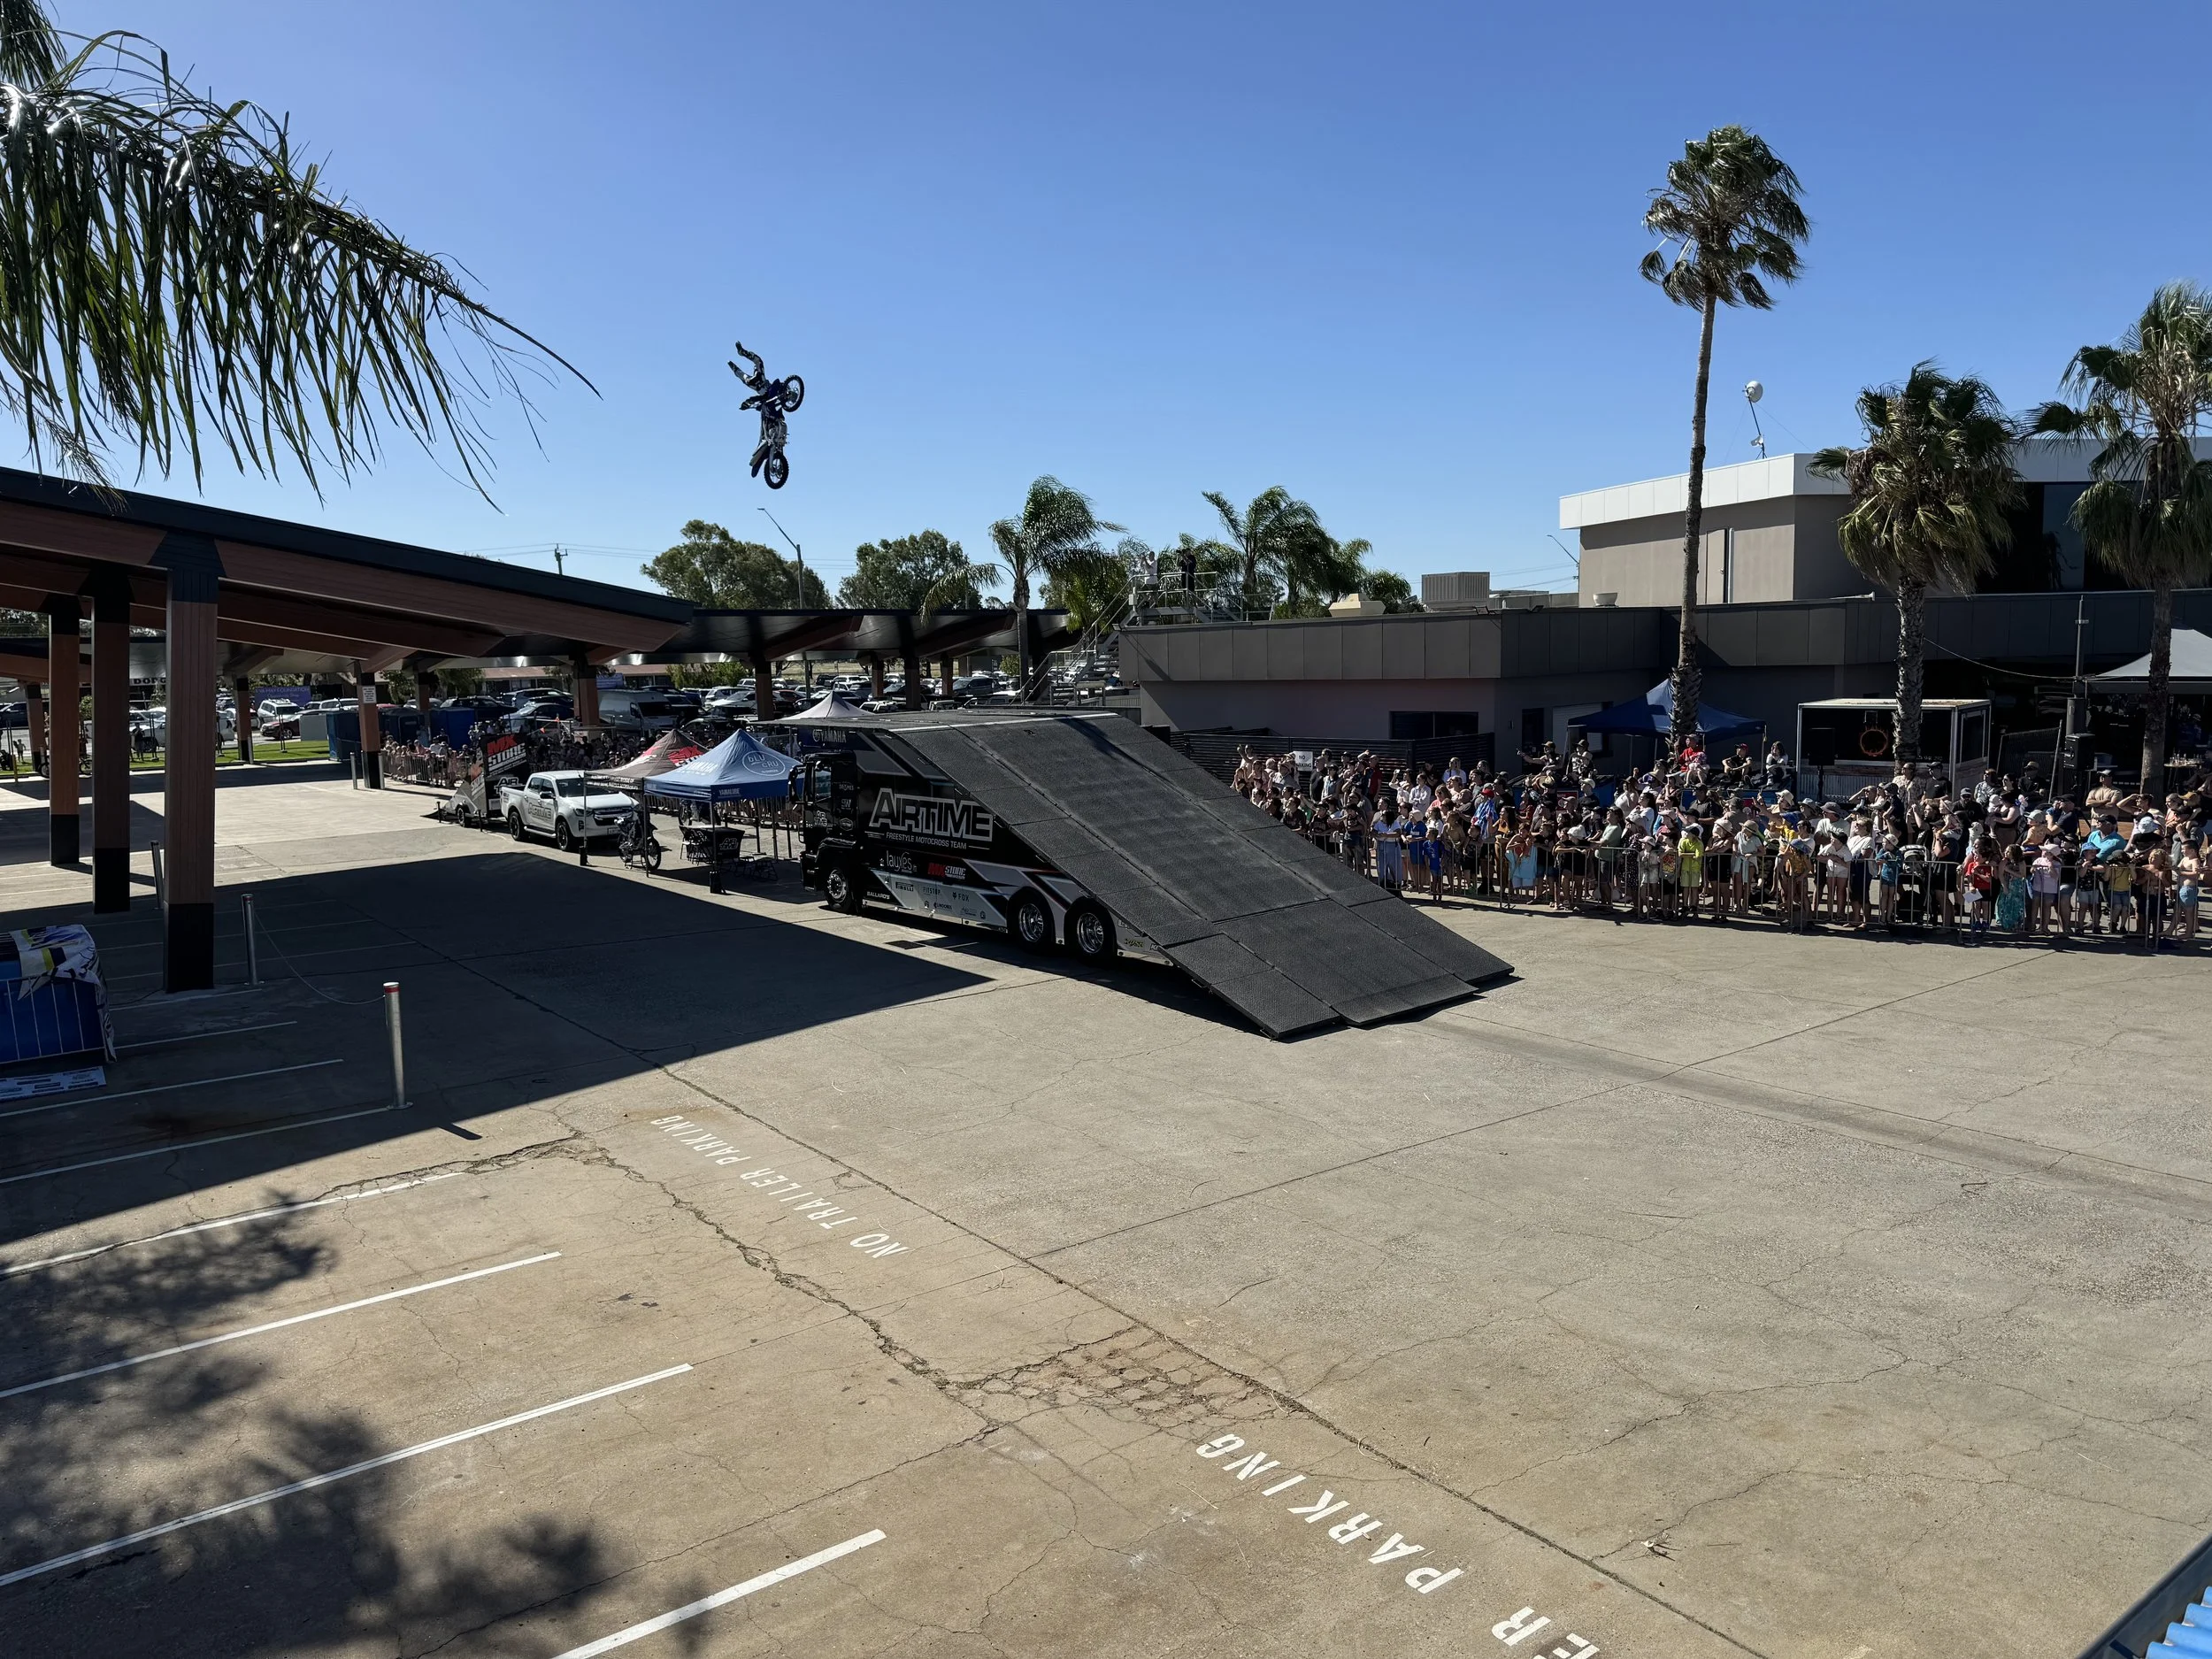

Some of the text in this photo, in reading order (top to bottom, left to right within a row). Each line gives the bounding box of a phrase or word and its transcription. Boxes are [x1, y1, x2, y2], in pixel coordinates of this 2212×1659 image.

[488, 734, 518, 756] MX
[821, 729, 847, 743] YAMAHA
[488, 743, 526, 766] STORE
[886, 832, 967, 849] FREESTYLE MOTOCROSS TEAM
[958, 893, 970, 902] FOX
[650, 1115, 909, 1258] NO TRAILER PARKING
[1195, 1433, 1464, 1594] PARKING
